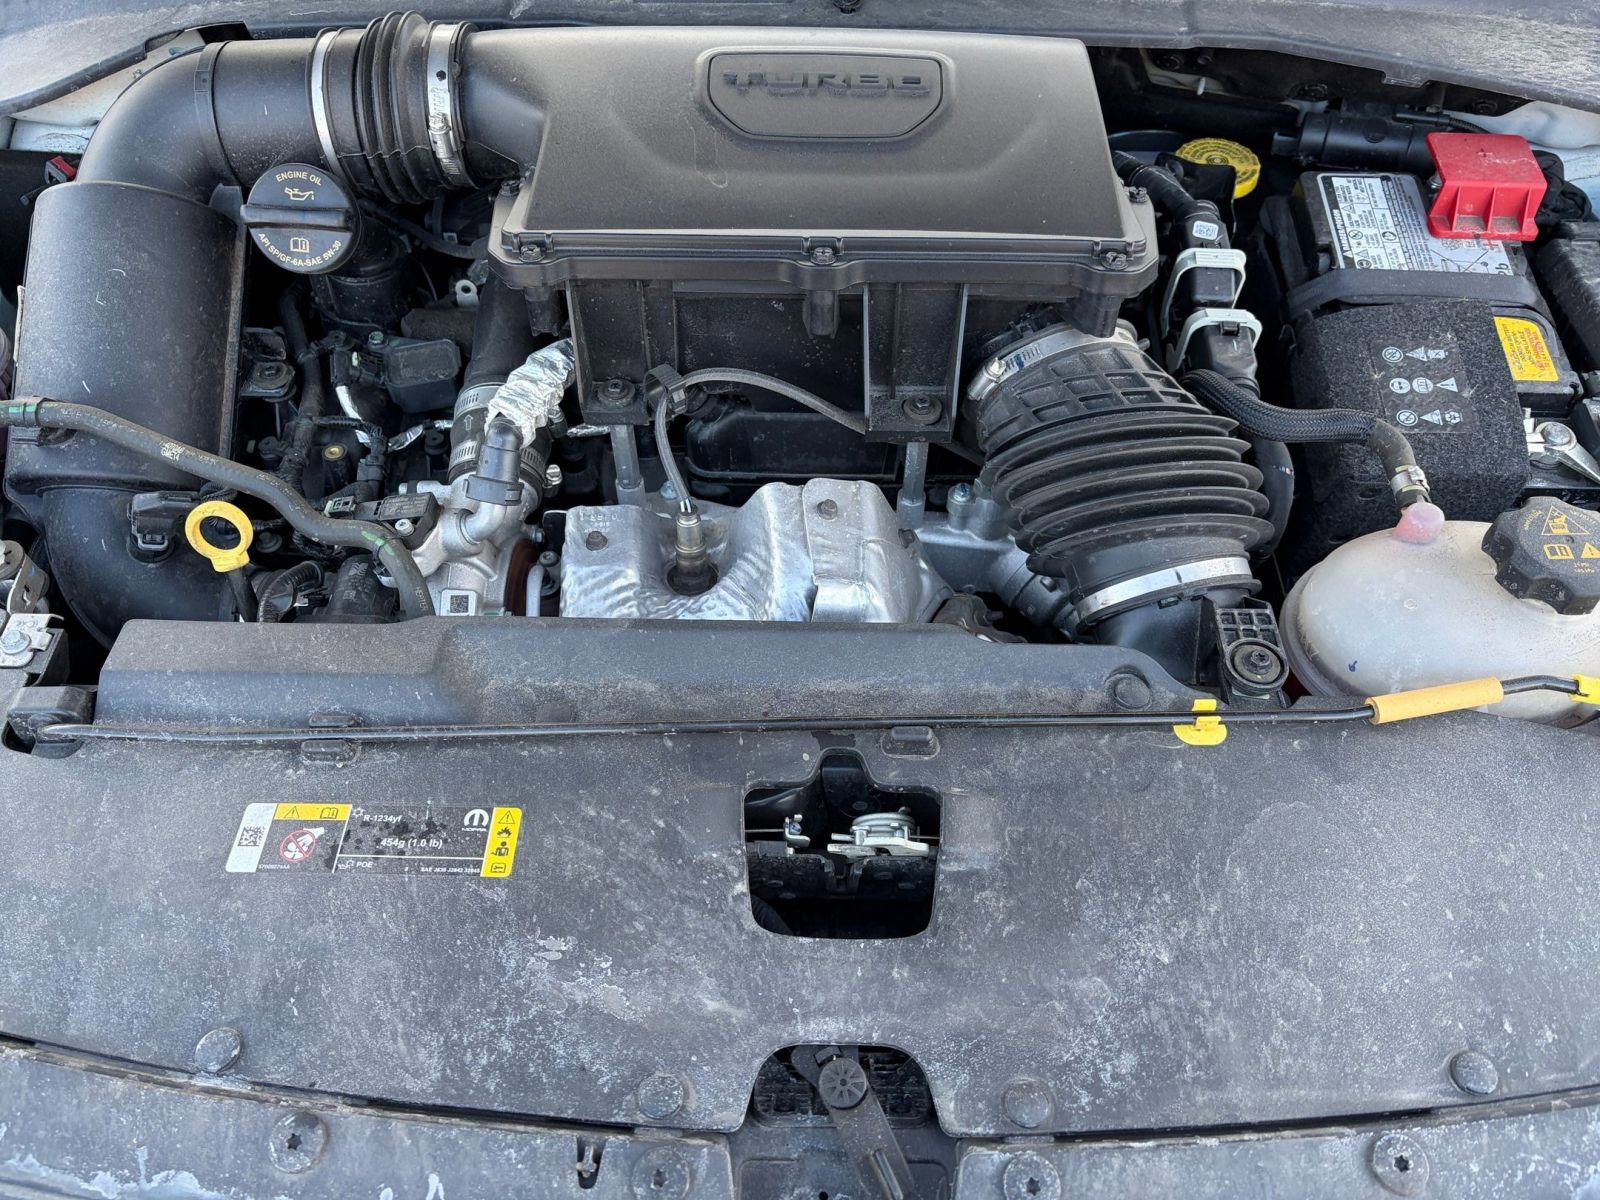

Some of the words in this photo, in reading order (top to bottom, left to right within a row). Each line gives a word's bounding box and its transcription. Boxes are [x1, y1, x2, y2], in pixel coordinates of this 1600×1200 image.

[275, 171, 308, 183] ENGINE
[309, 174, 322, 186] OIL
[258, 232, 270, 248] API
[323, 240, 342, 261] 5W-30
[363, 814, 402, 824] R-1234yf
[380, 838, 405, 849] 454g
[407, 838, 427, 849] (1.0
[429, 838, 443, 849] lb)
